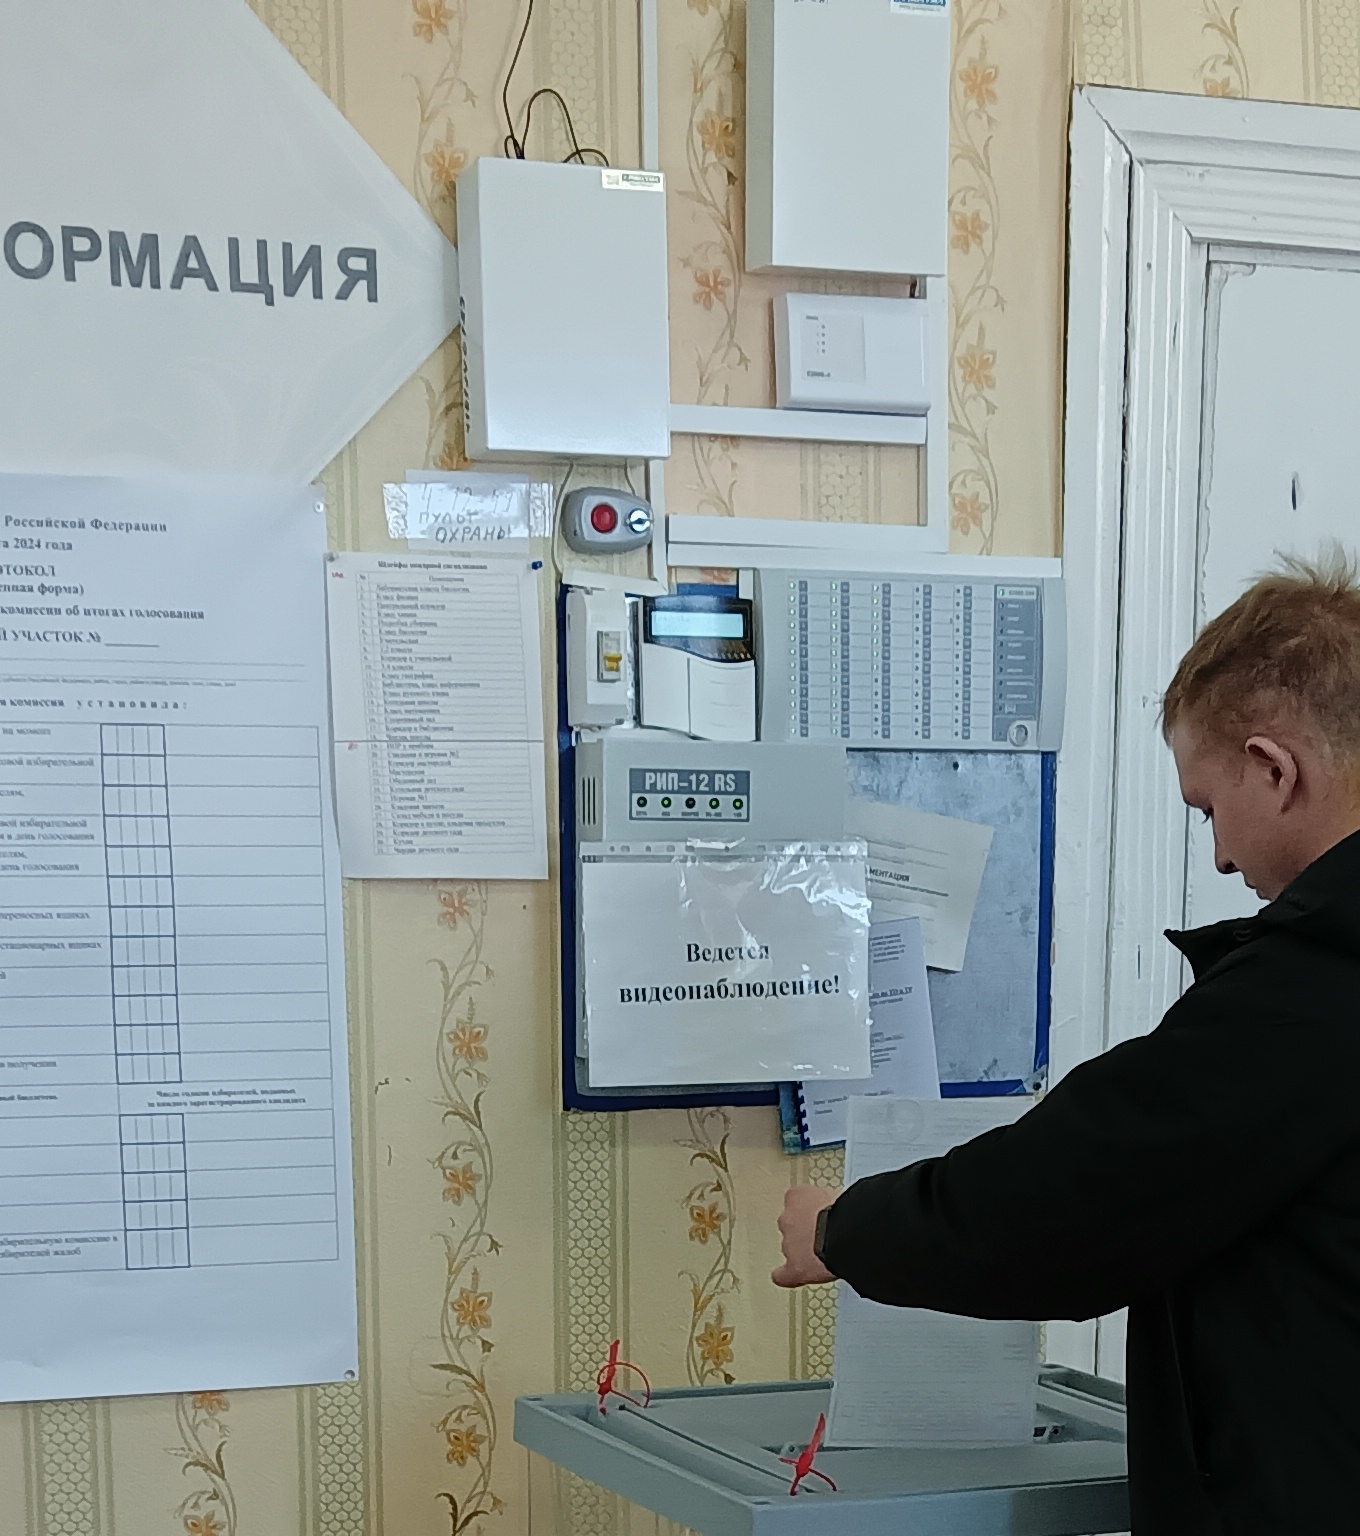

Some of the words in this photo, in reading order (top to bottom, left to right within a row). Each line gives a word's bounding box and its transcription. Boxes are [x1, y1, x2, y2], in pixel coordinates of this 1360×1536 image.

[4, 514, 86, 530] Российской
[90, 518, 168, 534] Федерации
[435, 524, 511, 544] ОХРАНЫ
[13, 538, 42, 549] 2024
[45, 540, 73, 551] года
[38, 582, 85, 597] форма)
[0, 605, 62, 617] комиссии
[65, 604, 80, 617] об
[83, 608, 126, 618] итогах
[129, 608, 205, 620] голосования
[11, 629, 85, 643] УЧАСТОК
[644, 771, 710, 791] РИП-12
[714, 773, 737, 792] RS
[686, 943, 770, 963] Ведется
[619, 975, 840, 1005] видеонаблюдение!
